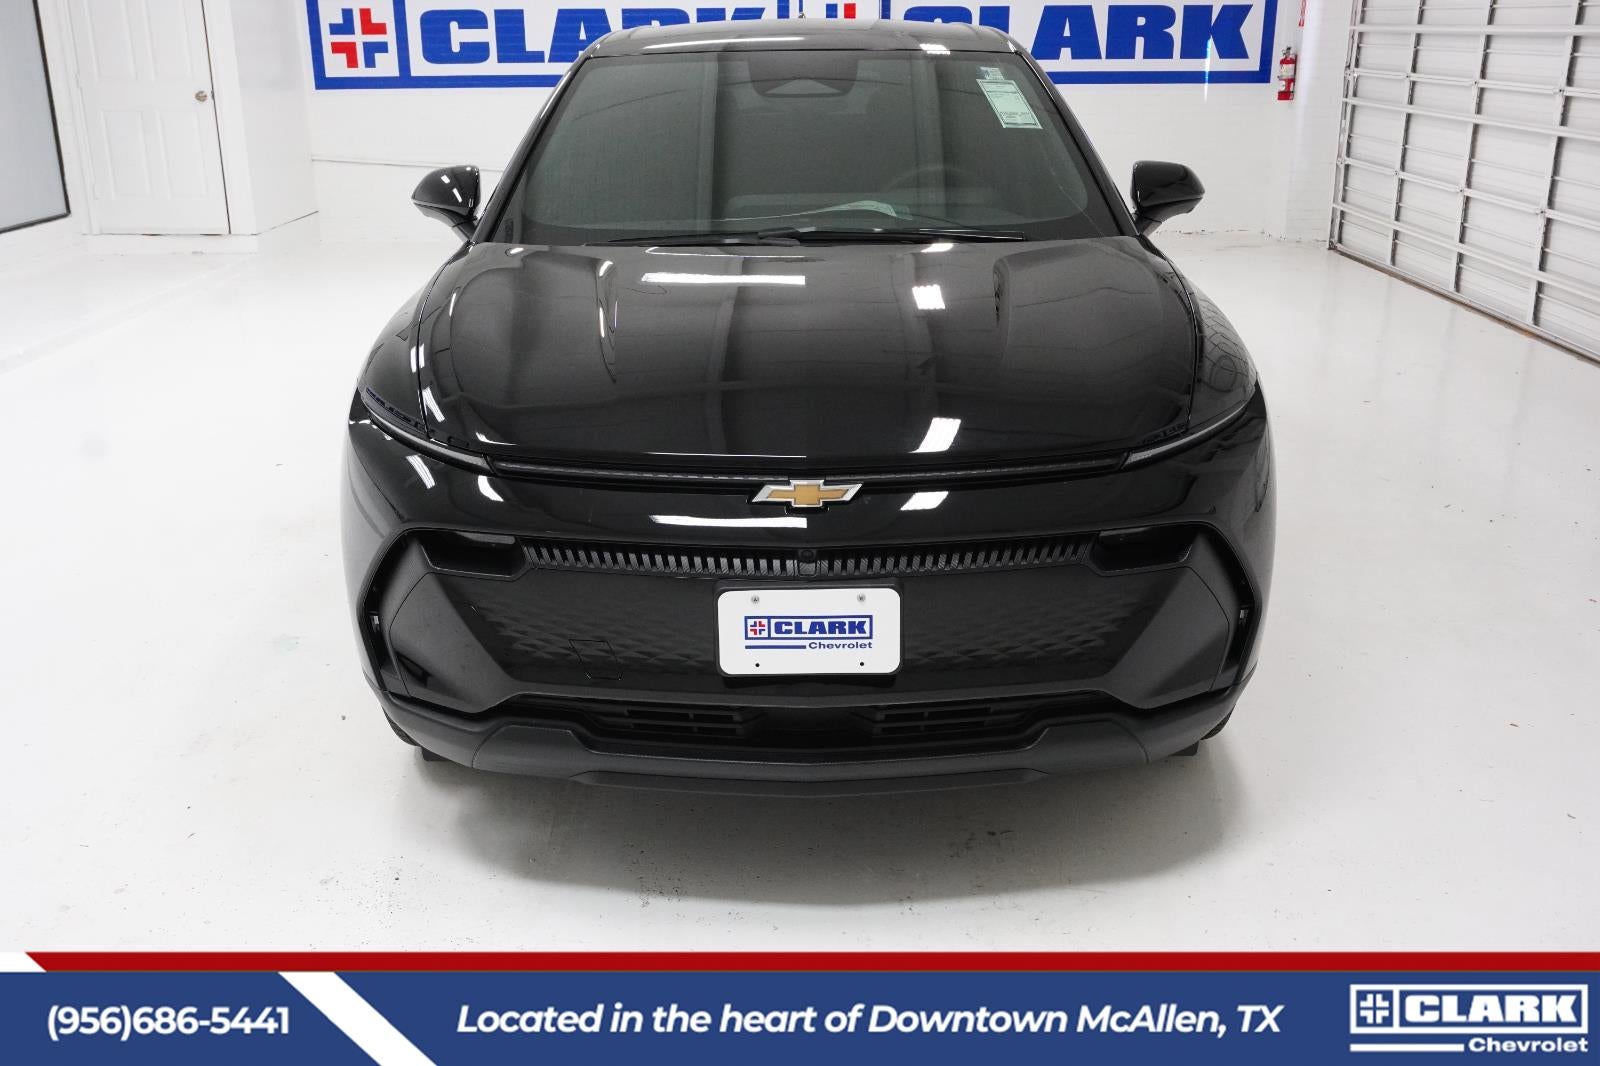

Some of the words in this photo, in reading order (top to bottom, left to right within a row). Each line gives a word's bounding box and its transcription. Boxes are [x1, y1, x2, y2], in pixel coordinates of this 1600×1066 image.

[420, 7, 765, 64] CLA
[774, 621, 867, 635] CLARK
[808, 641, 873, 650] Chevrolet
